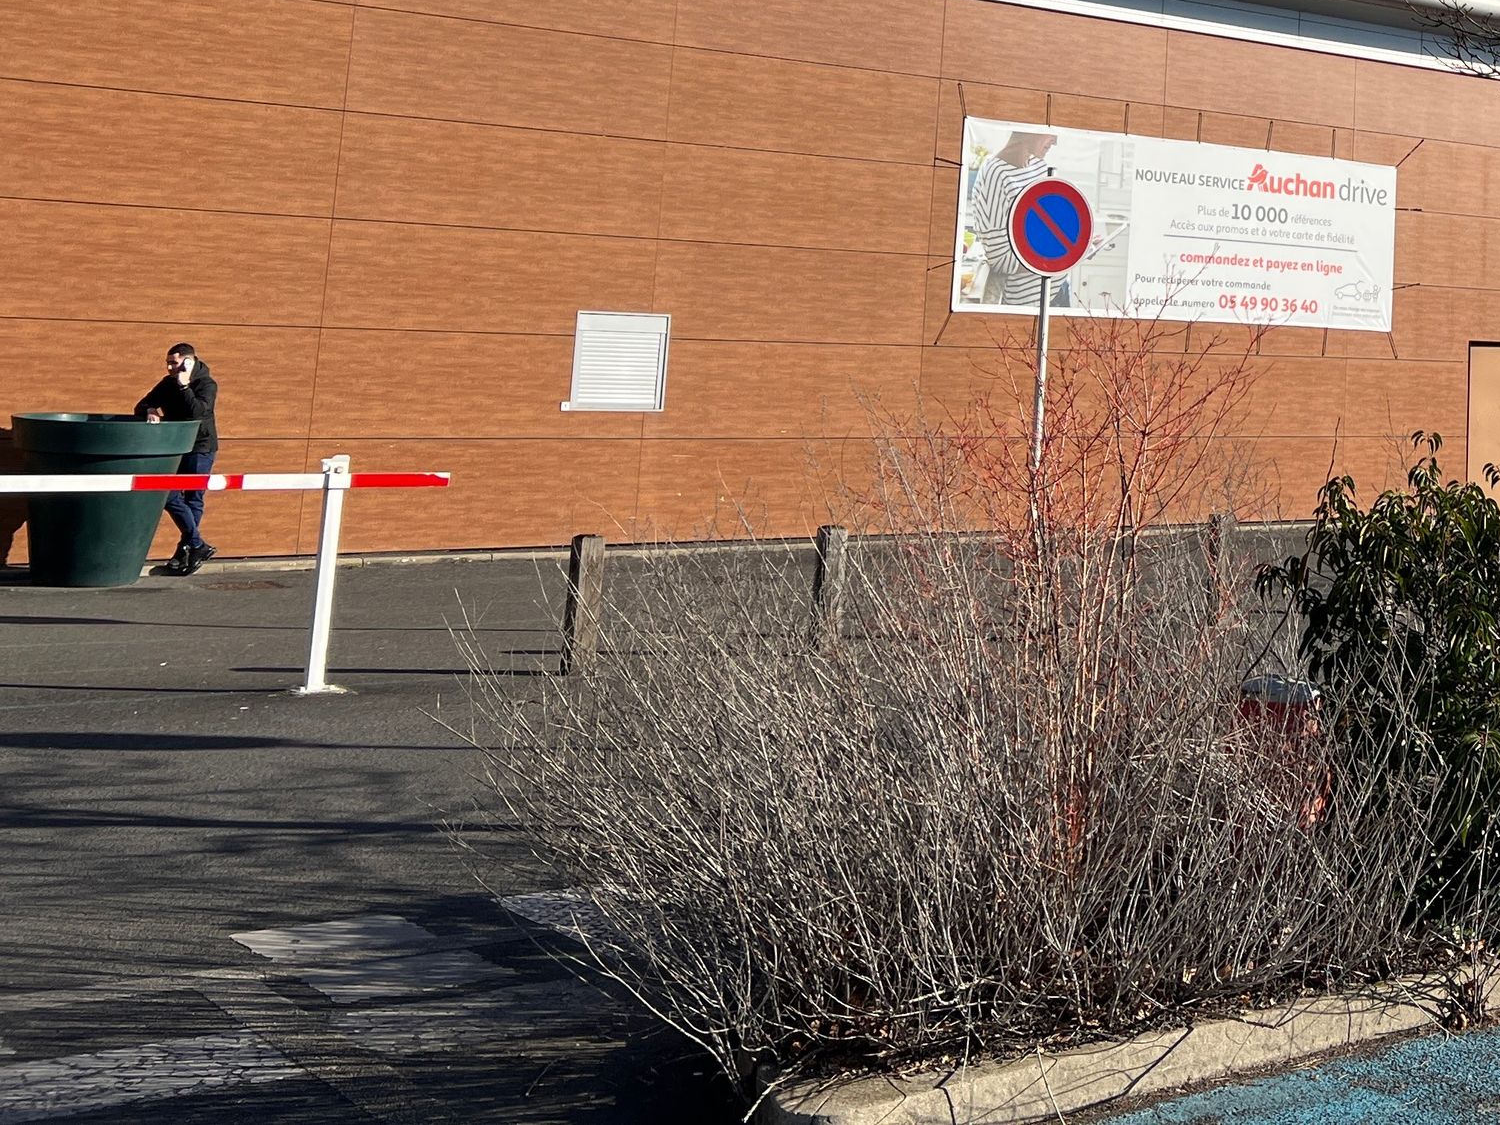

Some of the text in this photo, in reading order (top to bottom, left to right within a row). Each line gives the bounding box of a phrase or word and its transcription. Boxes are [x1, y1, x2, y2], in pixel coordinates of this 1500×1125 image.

[1135, 163, 1388, 206] NOUVEAU SERVICE Auchan drive
[1197, 204, 1217, 217] Plus
[1218, 206, 1230, 218] de
[1231, 203, 1251, 221] 10
[1255, 205, 1288, 224] 000
[1170, 219, 1196, 231] Accès
[1197, 222, 1215, 232] aux
[1216, 225, 1249, 236] promos
[1250, 227, 1260, 236] et
[1269, 228, 1291, 239] votre
[1292, 230, 1314, 241] carte
[1314, 232, 1325, 242] de
[1179, 251, 1343, 275] commandez et payez en ligne
[1134, 273, 1156, 284] Pour
[1200, 278, 1223, 287] votre
[1225, 279, 1271, 291] commande
[1219, 294, 1236, 309] 05
[1240, 296, 1257, 311] 49
[1260, 297, 1278, 312] 90
[1281, 298, 1298, 313] 36
[1300, 299, 1318, 314] 40
